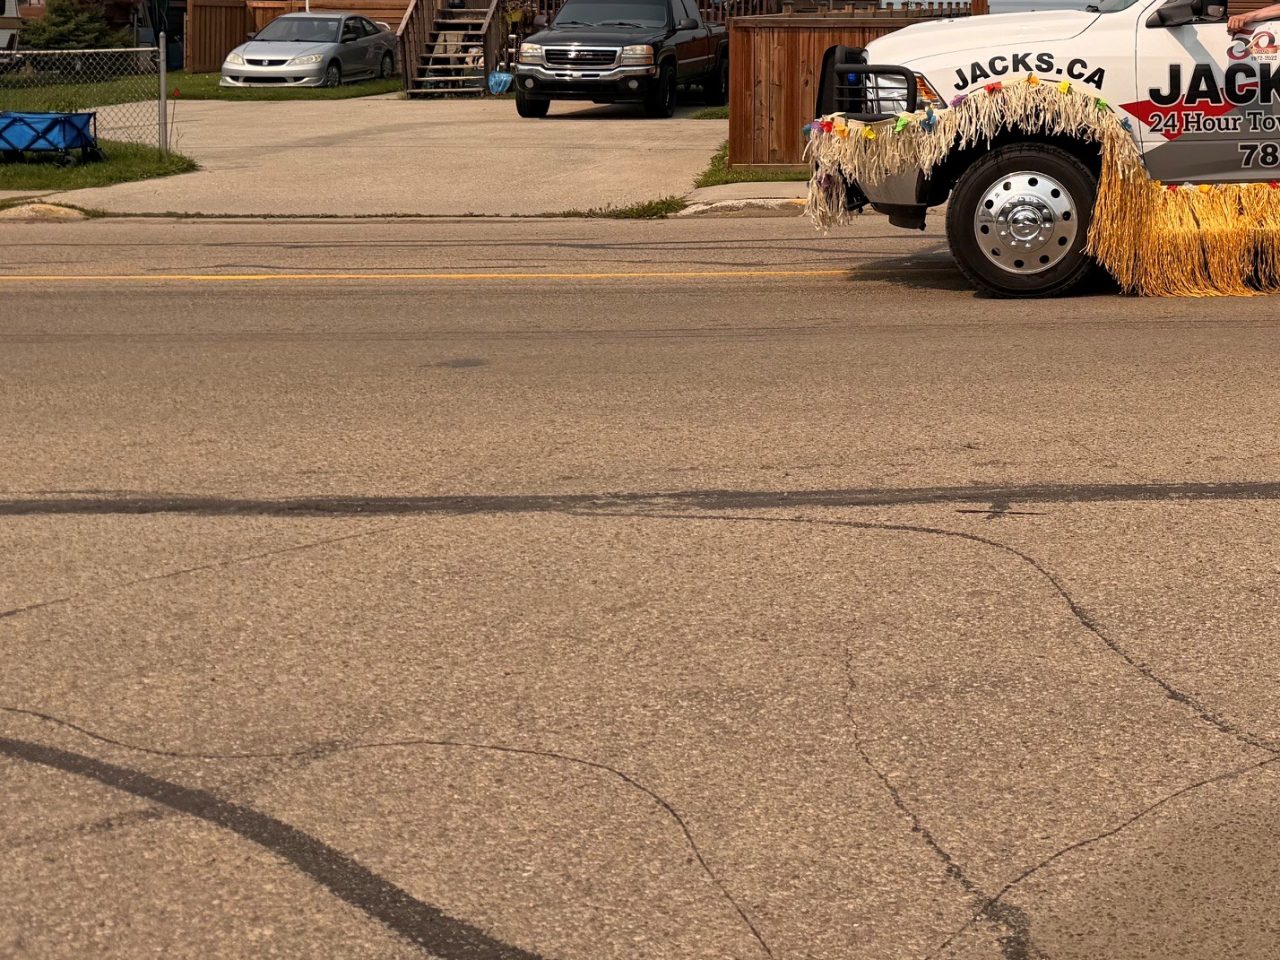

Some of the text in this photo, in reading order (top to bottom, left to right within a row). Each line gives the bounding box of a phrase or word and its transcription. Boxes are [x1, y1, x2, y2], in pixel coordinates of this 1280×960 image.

[953, 52, 1106, 91] JACKS.CA
[1149, 112, 1178, 133] 24
[1181, 112, 1243, 133] Hour
